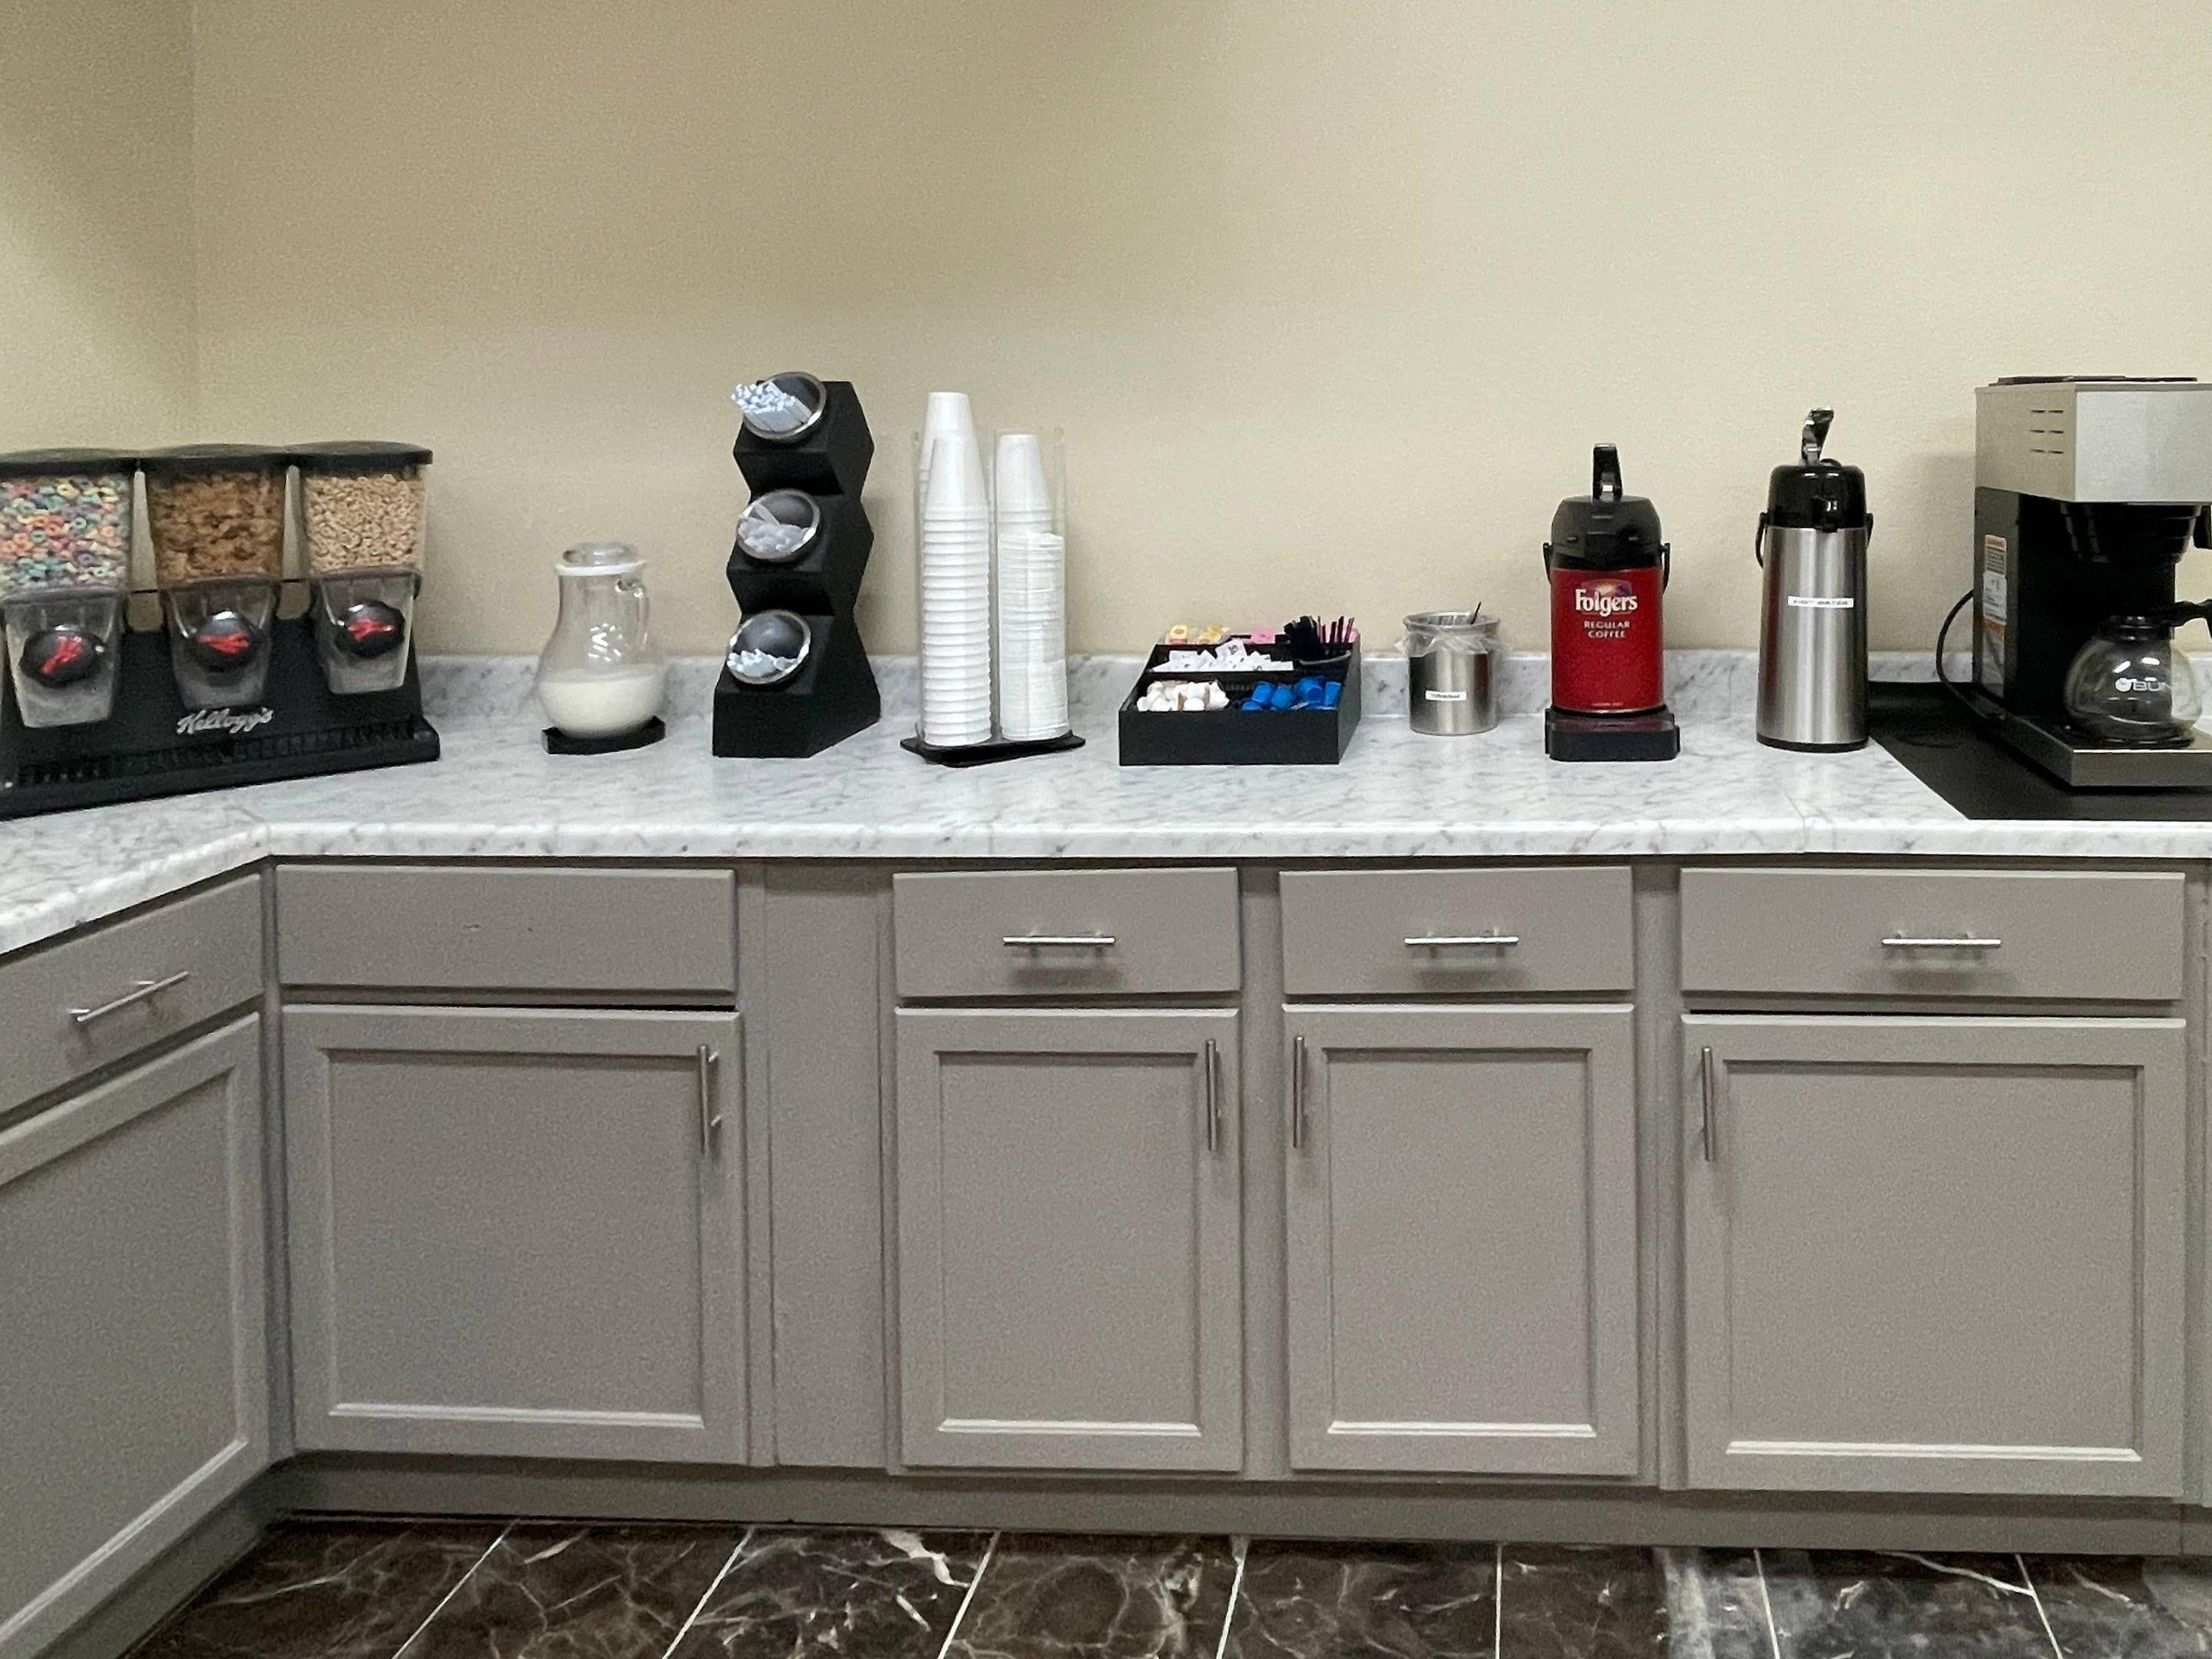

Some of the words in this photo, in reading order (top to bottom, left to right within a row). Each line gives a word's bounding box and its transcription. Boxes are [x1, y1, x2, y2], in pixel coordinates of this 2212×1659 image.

[1575, 588, 1637, 617] Folgers
[1584, 620, 1630, 628] REGULAR
[1588, 630, 1625, 638] COFFEE
[177, 707, 274, 734] Kellogg's
